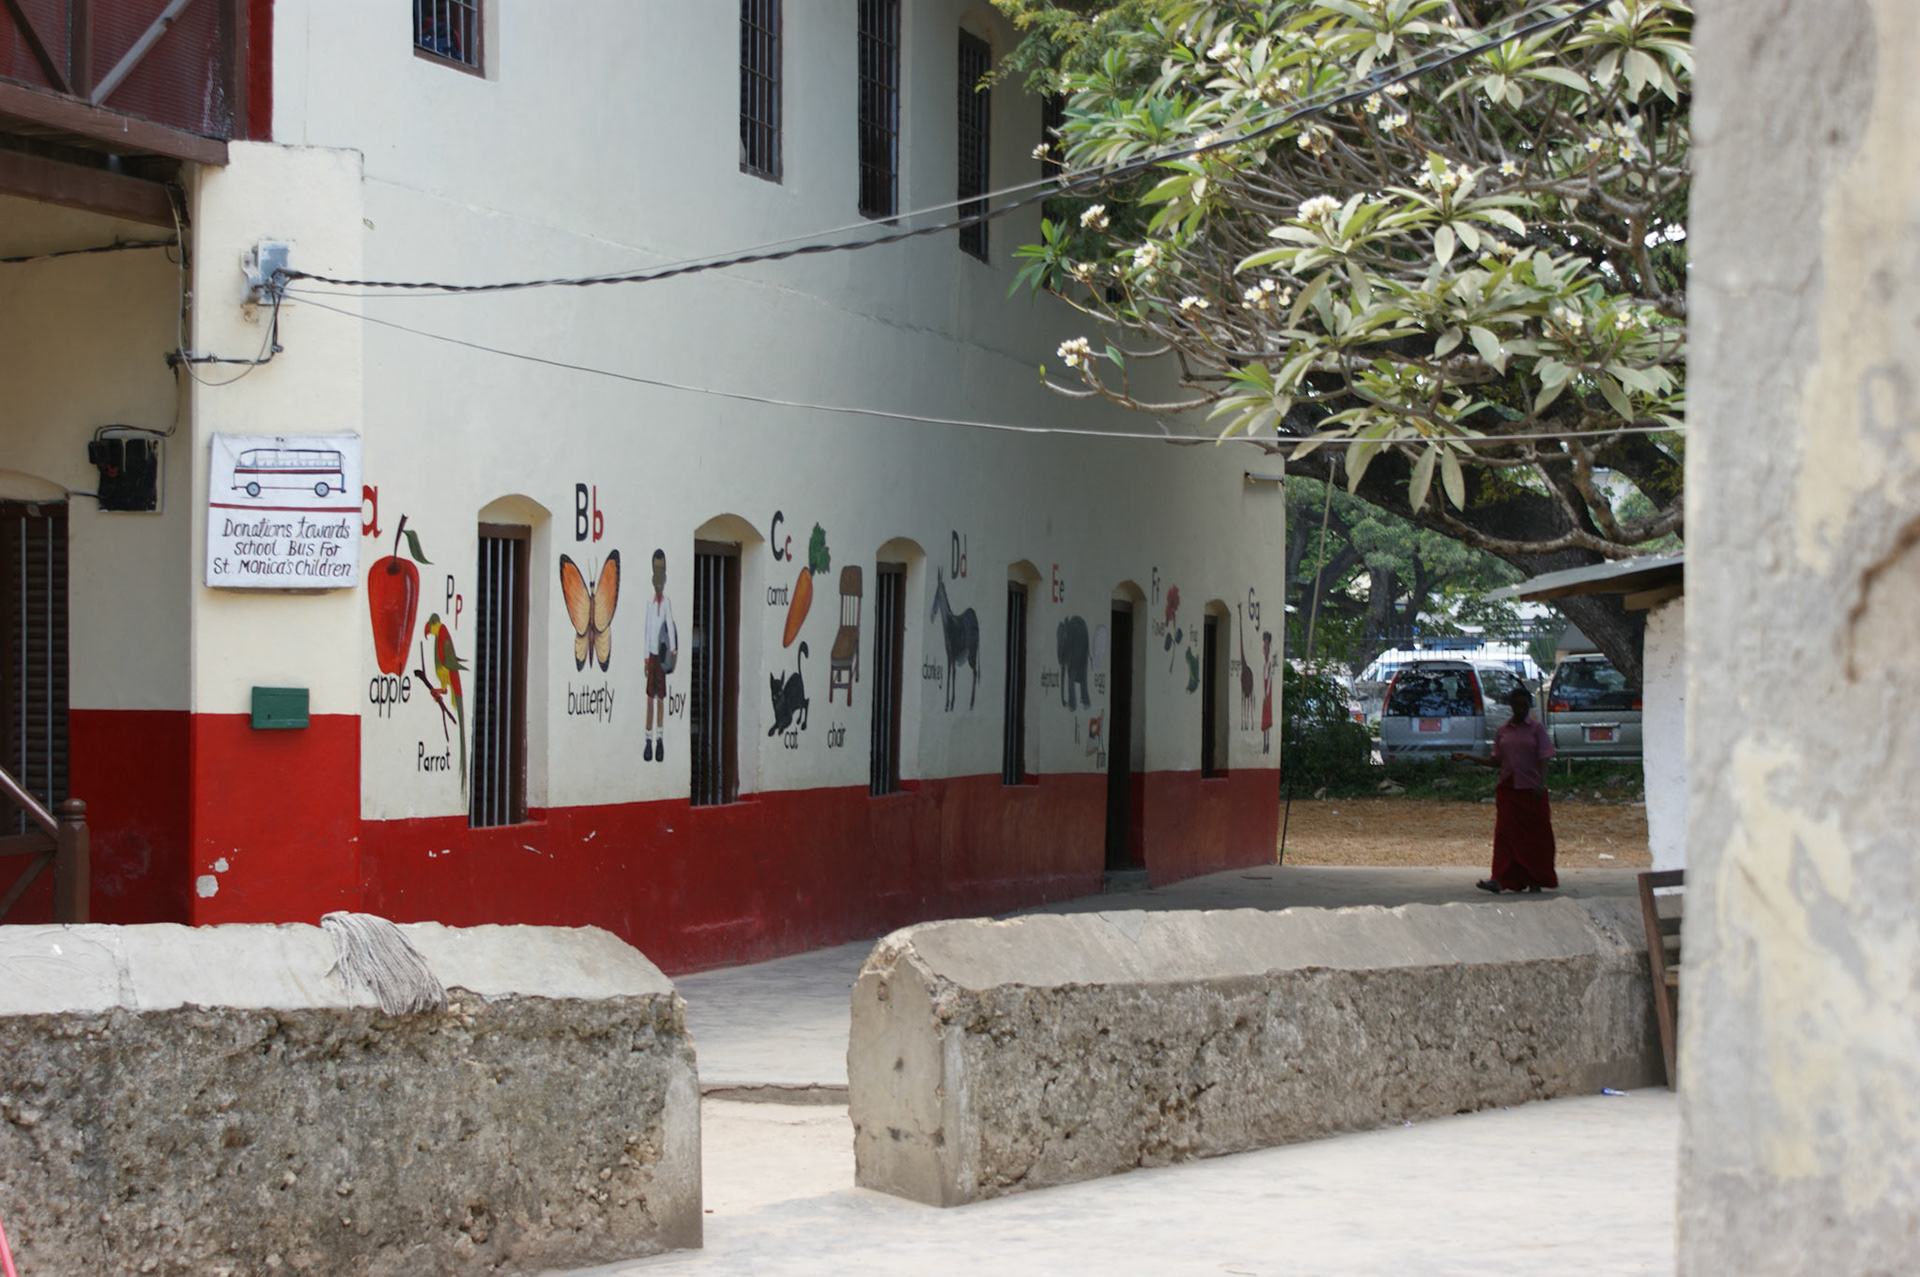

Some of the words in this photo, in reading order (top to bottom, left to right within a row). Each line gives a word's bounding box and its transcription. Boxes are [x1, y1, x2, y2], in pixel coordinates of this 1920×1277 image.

[222, 517, 293, 538] Donations
[296, 516, 351, 539] towards
[234, 539, 278, 557] school
[319, 541, 342, 557] For
[295, 558, 352, 577] Children
[369, 673, 412, 719] apple
[567, 681, 614, 723] butterfly
[668, 685, 686, 719] boy
[784, 727, 799, 749] cat
[827, 722, 846, 749] chair
[418, 741, 451, 772] Parrot
